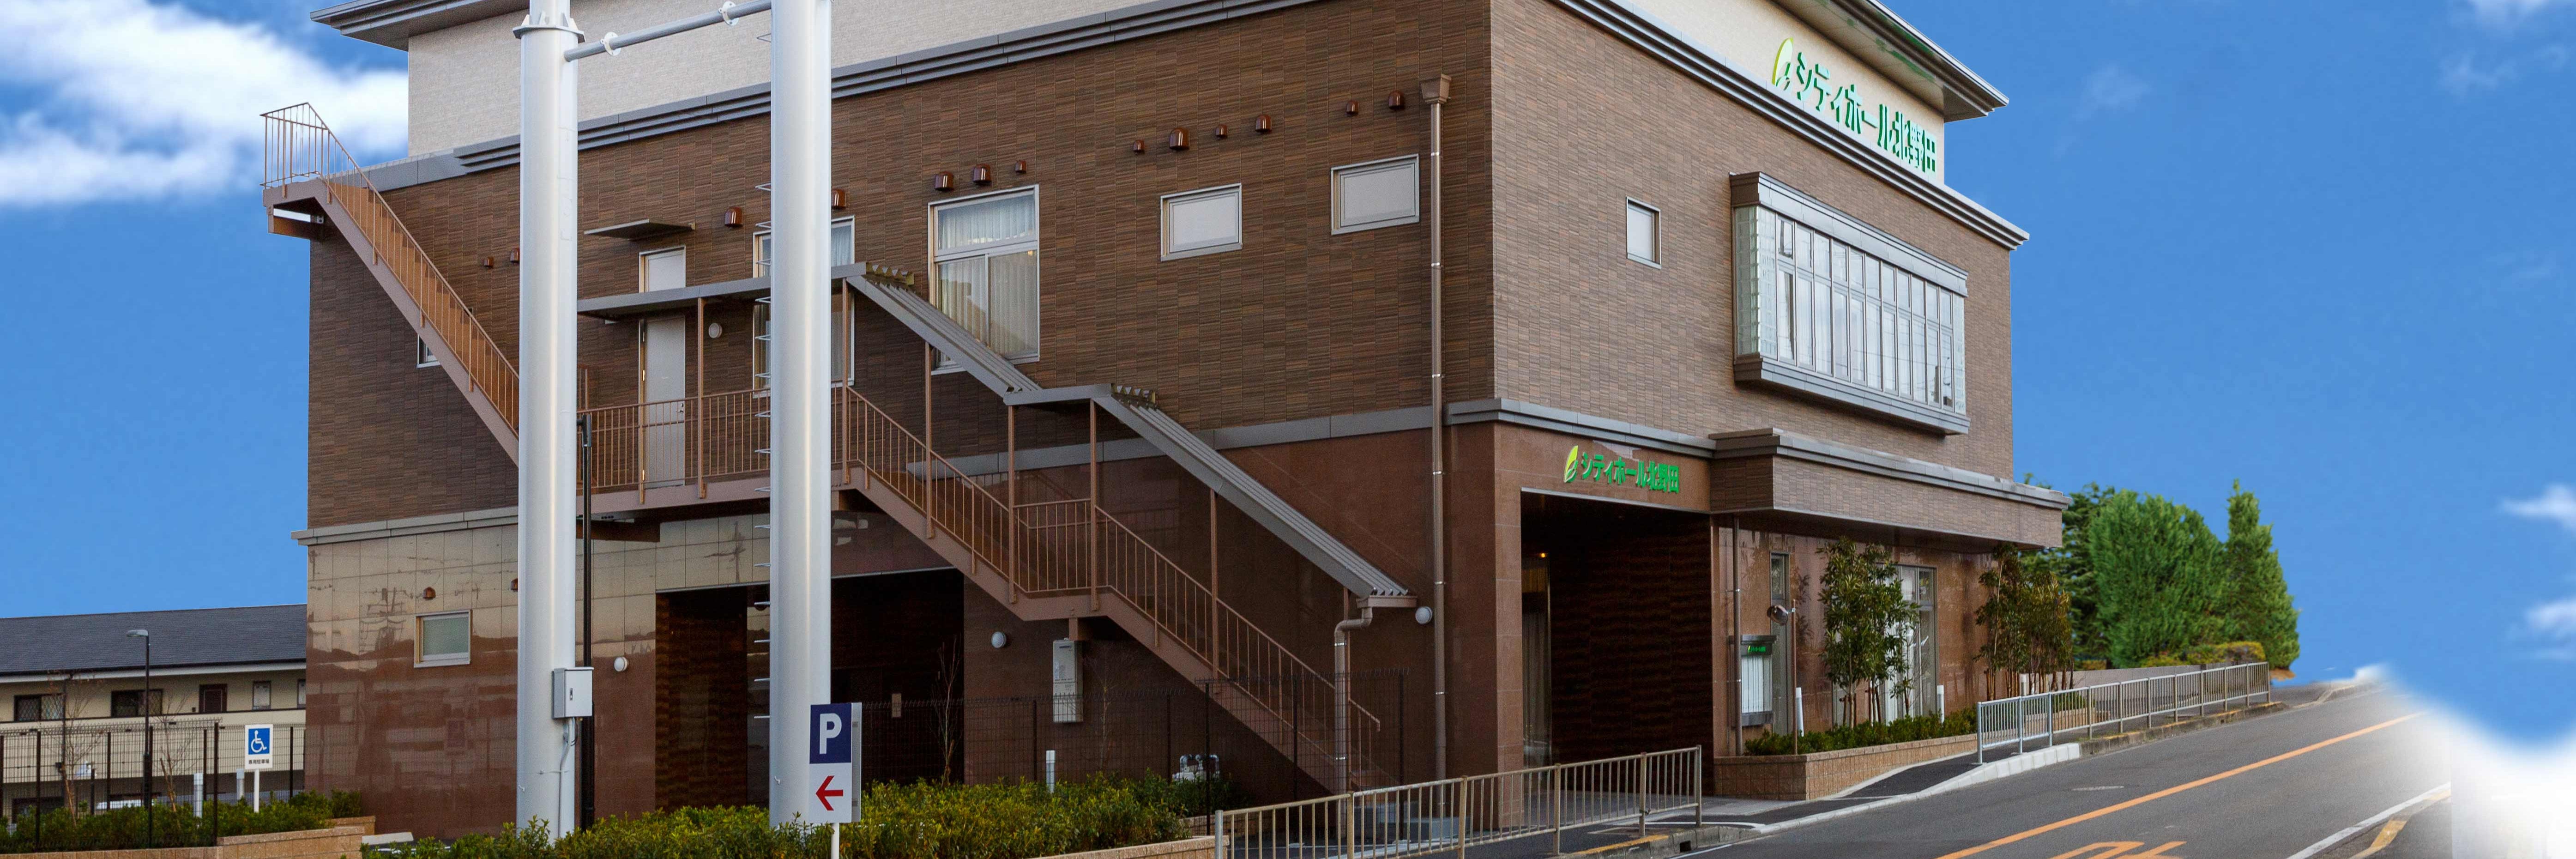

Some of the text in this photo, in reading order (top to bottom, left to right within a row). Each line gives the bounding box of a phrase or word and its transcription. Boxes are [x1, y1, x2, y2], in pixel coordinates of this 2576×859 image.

[1797, 52, 1937, 175] シティホール北野田
[1581, 452, 1679, 493] シティホール北野田
[819, 713, 842, 754] P
